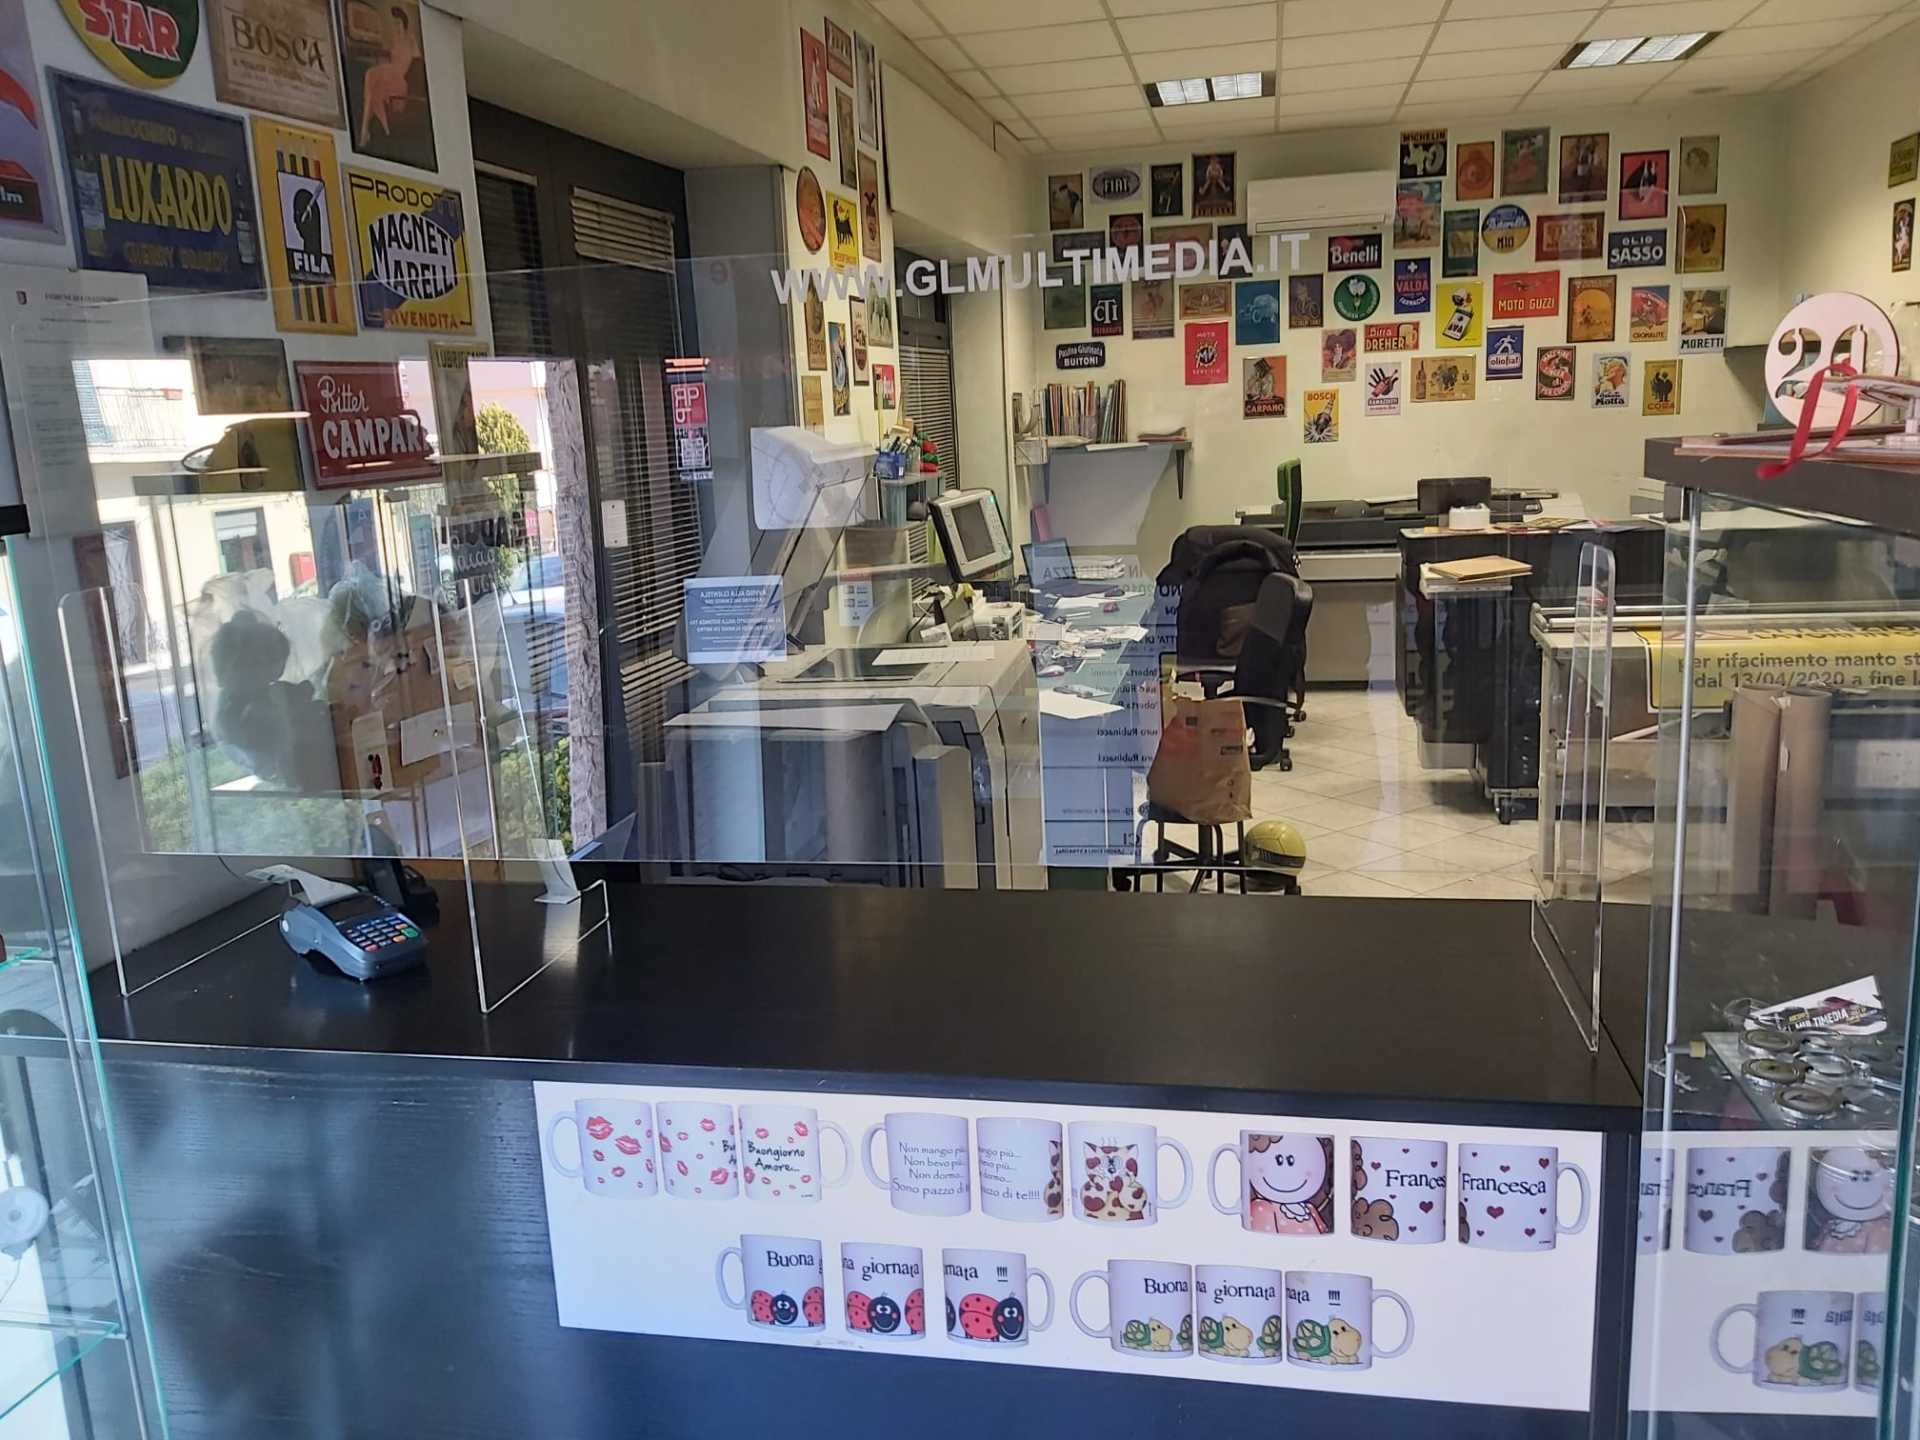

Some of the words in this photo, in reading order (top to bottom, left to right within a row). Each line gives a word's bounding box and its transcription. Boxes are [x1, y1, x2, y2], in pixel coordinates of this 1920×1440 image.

[78, 0, 181, 61] STAR
[231, 14, 327, 76] BOSCA
[100, 153, 233, 236] LUXARDO
[1621, 235, 1653, 246] OLIO
[1331, 244, 1379, 265] Benelli
[1610, 245, 1664, 264] SASSO
[293, 252, 332, 275] FILA
[771, 232, 1310, 305] WWW.GLMULTIMEDIA.IT
[1498, 299, 1525, 312] MOTO
[1529, 297, 1555, 310] GUZZI
[1370, 326, 1393, 338] Birra
[1366, 337, 1406, 351] DREHER
[1681, 337, 1724, 350] MORETTI
[1063, 355, 1099, 368] BUITONI
[1307, 391, 1336, 401] BOSCH
[1595, 397, 1625, 407] Motta
[1245, 402, 1285, 416] CARPANO
[1717, 652, 1828, 669] rifacimento
[1834, 653, 1896, 668] manto
[1694, 672, 1722, 689] dal
[1730, 671, 1845, 687] 13/04/2020
[1851, 674, 1862, 686] a
[1869, 671, 1906, 687] fine
[747, 1140, 806, 1161] Buongiorno
[898, 1142, 920, 1154] Non
[922, 1146, 953, 1158] mango
[903, 1156, 925, 1167] Non
[927, 1157, 950, 1168] bevo
[908, 1168, 931, 1180] Non
[891, 1179, 920, 1195] Sono
[922, 1186, 954, 1199] pazzo
[1462, 1172, 1547, 1196] Francesca
[1002, 1187, 1013, 1199] di
[766, 1250, 814, 1267] Buona
[862, 1256, 919, 1281] giornata
[1144, 1278, 1188, 1295] Buona
[1214, 1282, 1276, 1304] giornata
